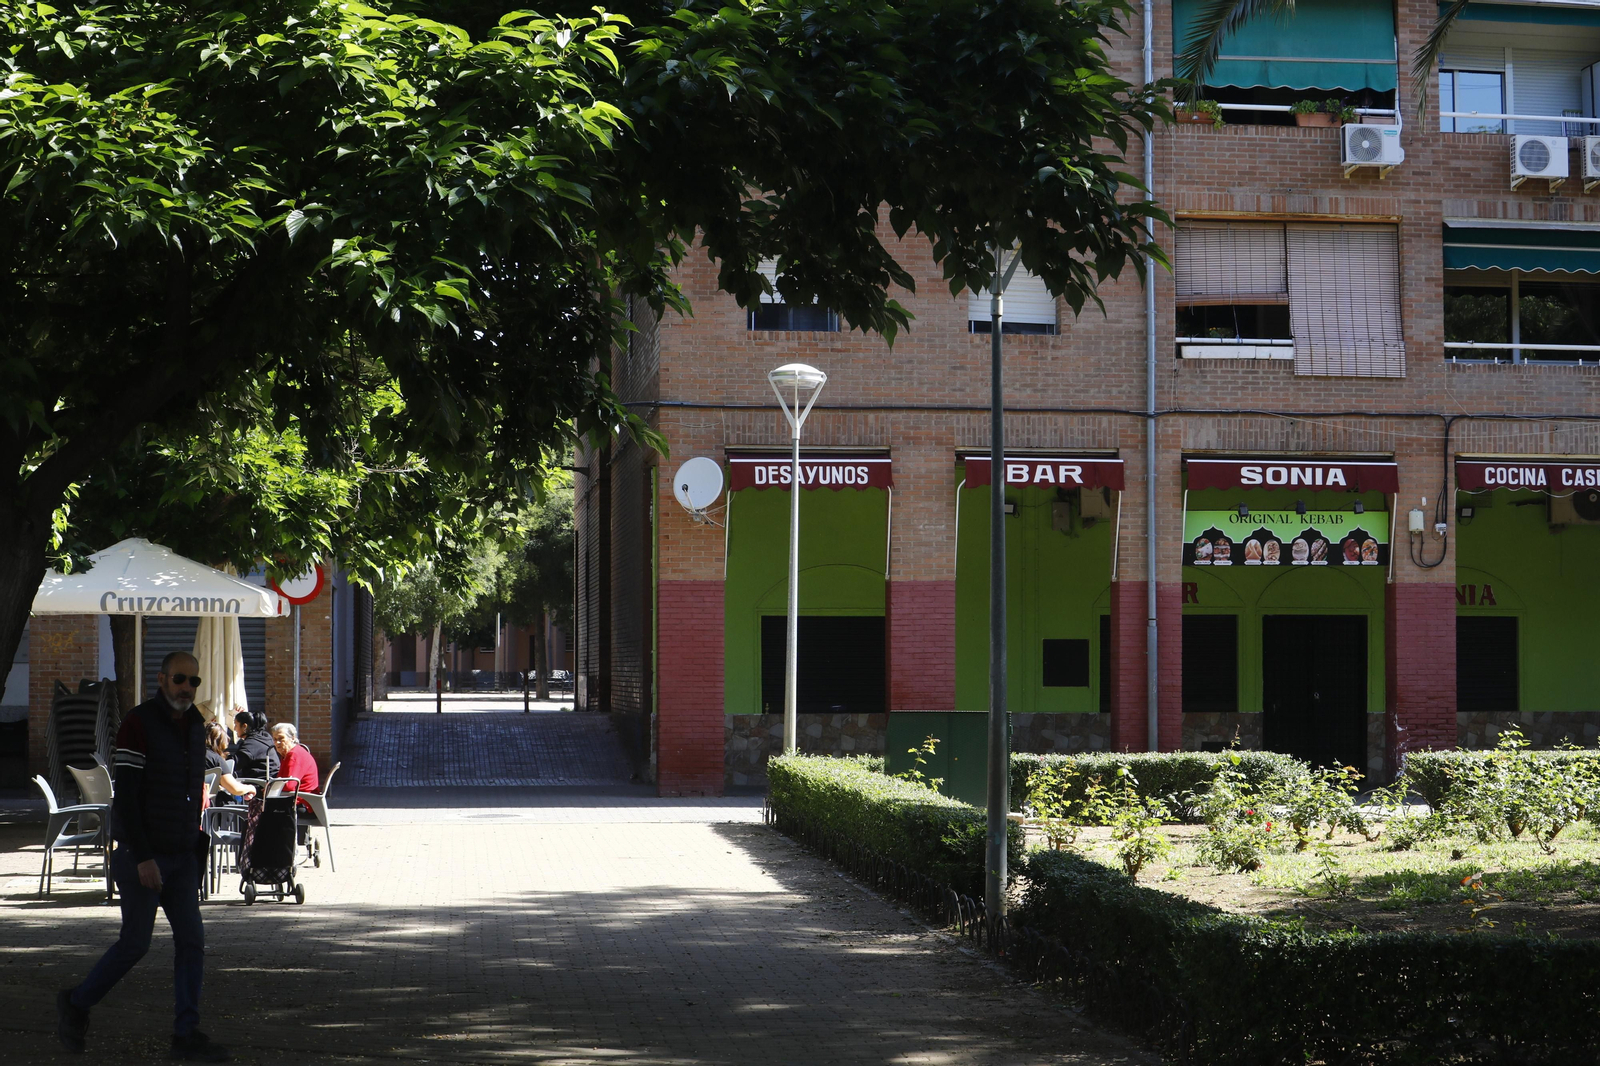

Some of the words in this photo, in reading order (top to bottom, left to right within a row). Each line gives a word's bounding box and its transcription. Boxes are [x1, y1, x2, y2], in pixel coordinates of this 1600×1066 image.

[754, 465, 869, 485] DESAYUNOS
[1006, 464, 1084, 484] BAR
[1240, 466, 1347, 486] SONIA
[1484, 466, 1547, 486] COCINA
[1229, 513, 1293, 525] ORIGINAL
[1300, 513, 1344, 525] KEBAB
